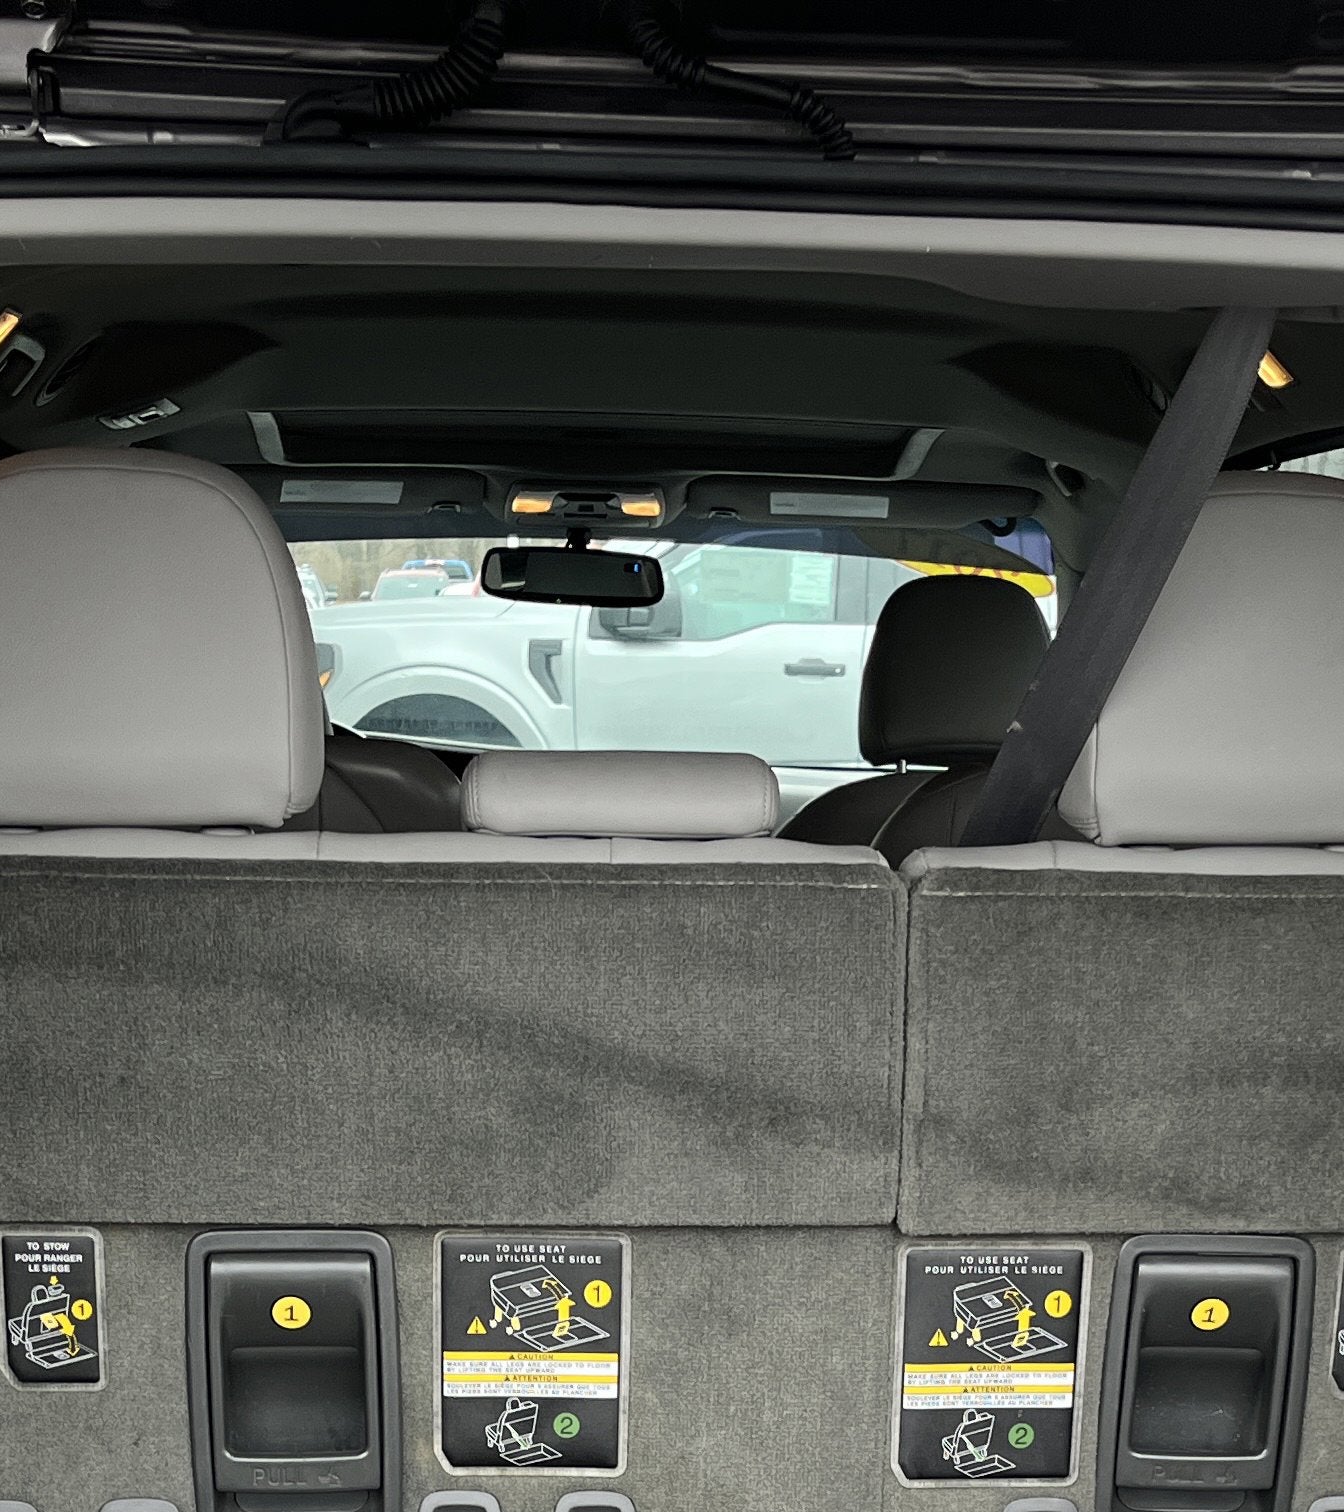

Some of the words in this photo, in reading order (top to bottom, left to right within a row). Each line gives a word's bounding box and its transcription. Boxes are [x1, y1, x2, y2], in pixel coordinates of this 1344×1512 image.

[27, 1242, 40, 1251] TO
[43, 1242, 70, 1251] STOW
[496, 1244, 510, 1252] TO
[514, 1245, 534, 1253] USE
[539, 1245, 566, 1253] SEAT
[14, 1254, 42, 1263] POUR
[44, 1254, 83, 1263] RANGER
[459, 1254, 490, 1263] POUR
[496, 1255, 546, 1263] UTILISER
[552, 1255, 565, 1264] LE
[960, 1256, 974, 1264] TO
[978, 1256, 998, 1264] USE
[1002, 1256, 1029, 1264] SEAT
[28, 1264, 41, 1273] LE
[925, 1266, 954, 1274] POUR
[960, 1266, 1009, 1274] UTILISER
[1015, 1266, 1027, 1274] LE
[284, 1305, 299, 1321] 1
[1201, 1307, 1216, 1324] 1
[559, 1416, 573, 1435] 2
[1014, 1427, 1027, 1445] 2
[253, 1468, 306, 1486] PULL
